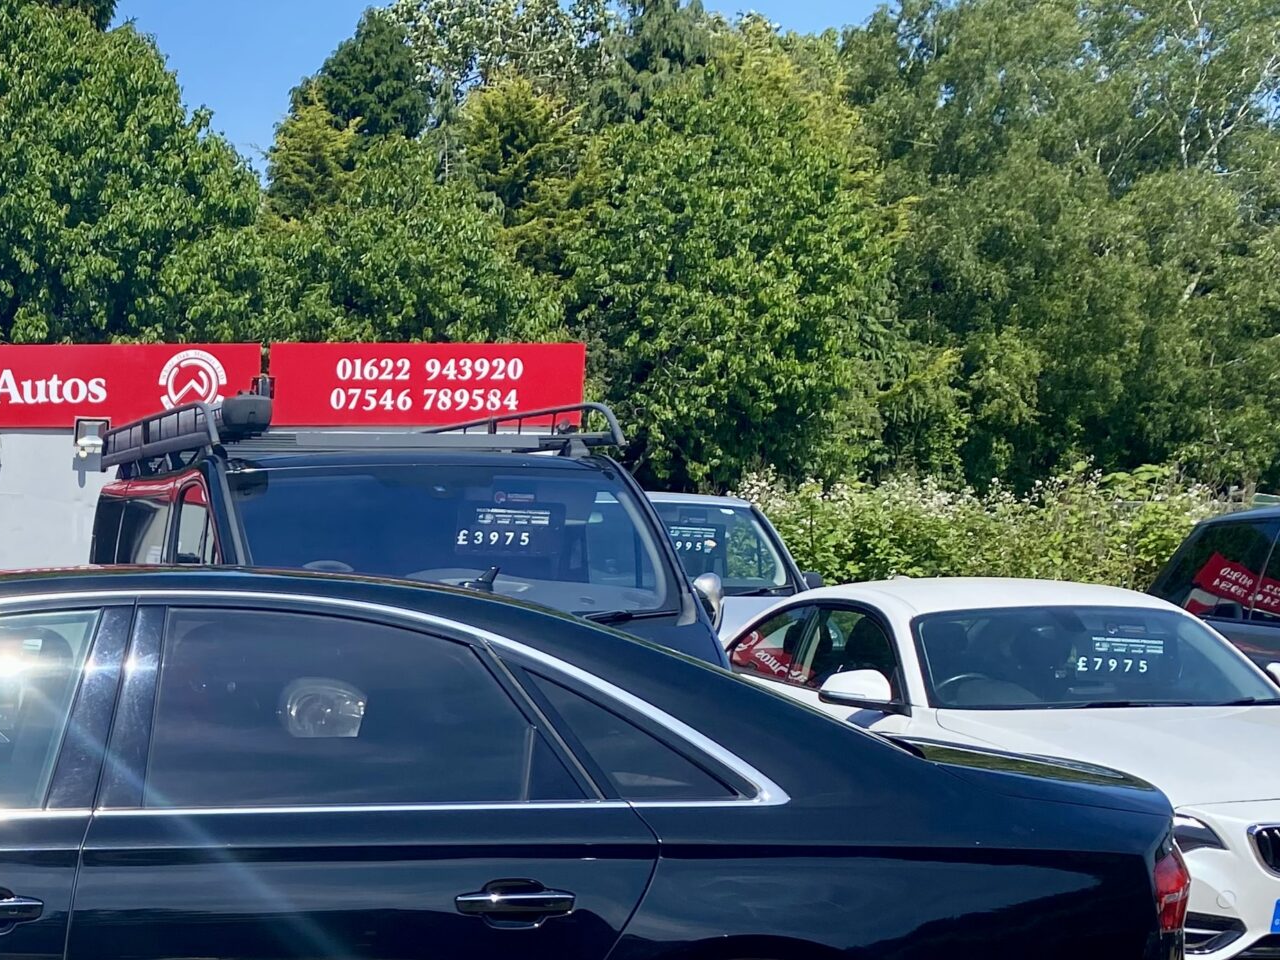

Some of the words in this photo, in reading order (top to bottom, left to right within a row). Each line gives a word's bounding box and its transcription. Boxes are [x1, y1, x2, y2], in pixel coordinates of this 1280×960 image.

[336, 358, 411, 381] 01622
[425, 357, 524, 381] 943920
[330, 388, 413, 411] 07546
[422, 388, 519, 411] 789584
[457, 529, 530, 546] £3975
[1077, 656, 1148, 673] £7975
